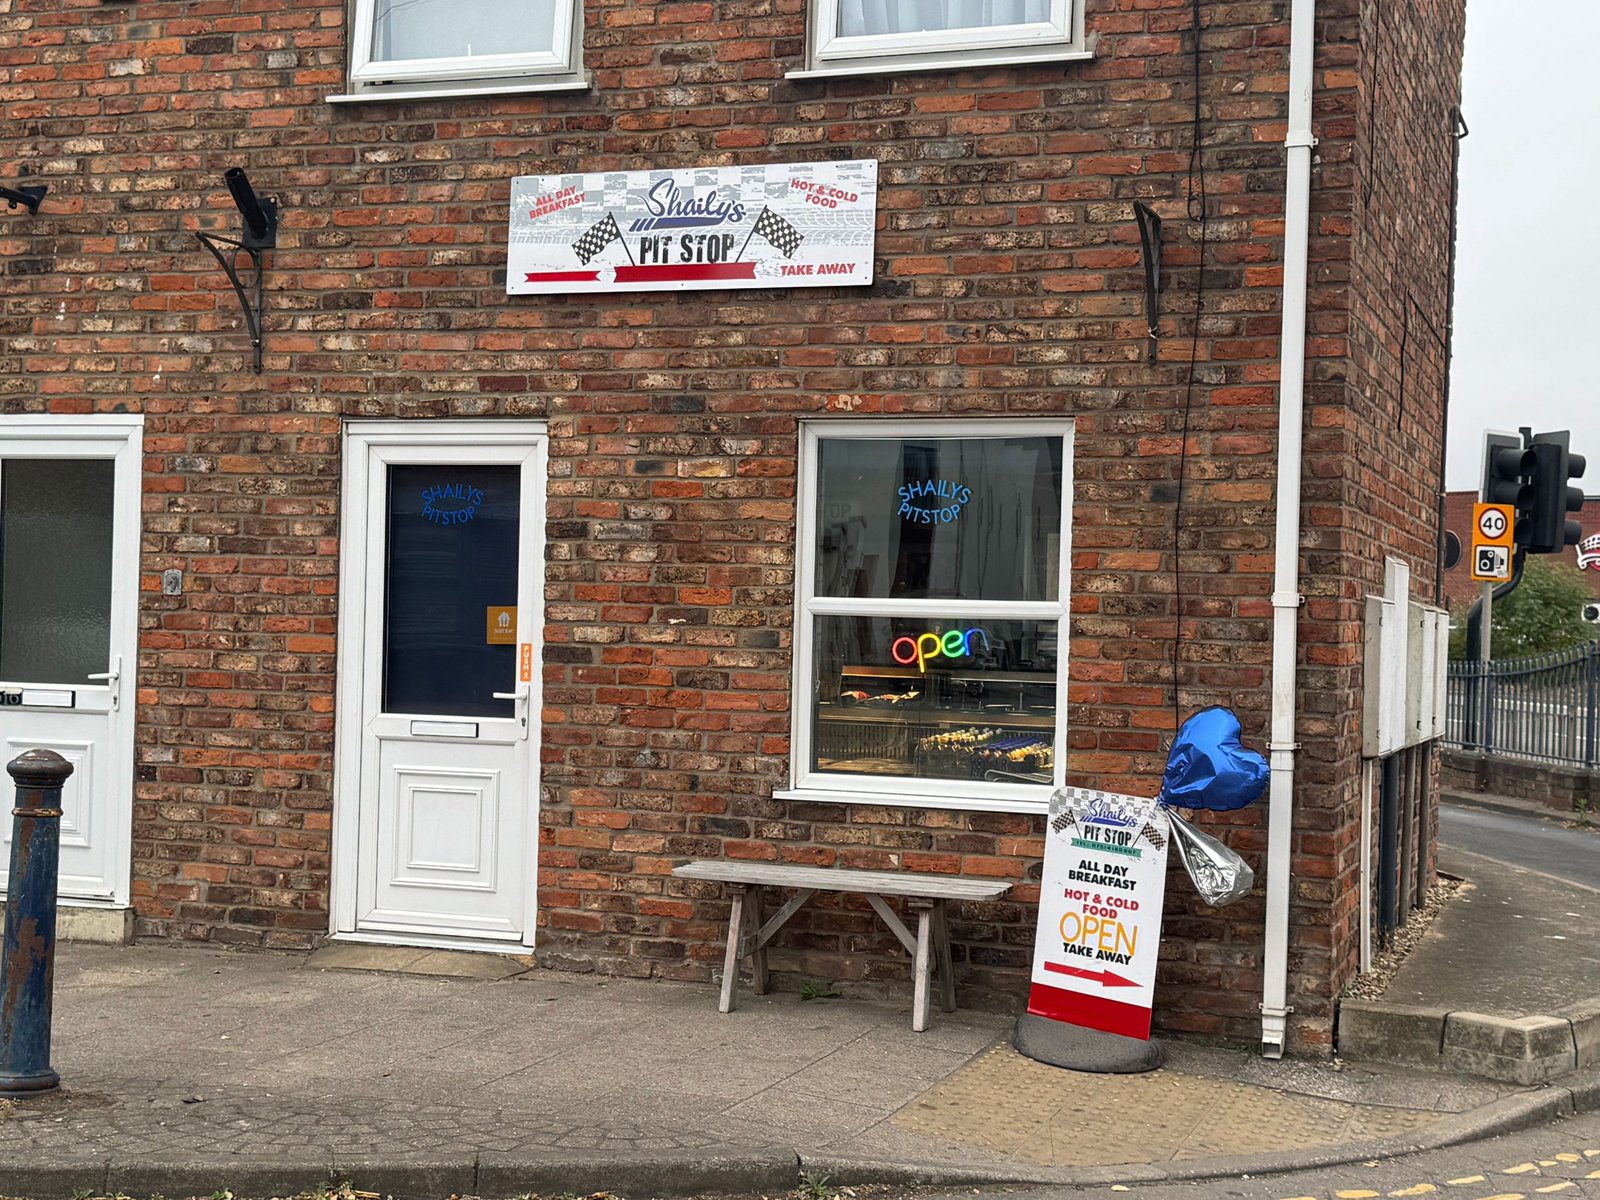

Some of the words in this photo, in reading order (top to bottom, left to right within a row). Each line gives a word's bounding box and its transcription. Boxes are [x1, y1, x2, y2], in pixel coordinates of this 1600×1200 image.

[535, 196, 553, 207] ALL
[556, 186, 577, 199] DAY
[640, 178, 747, 222] Shaily's
[791, 179, 814, 193] HOT
[816, 185, 827, 196] &
[828, 188, 858, 203] COLD
[805, 194, 838, 209] FOOD
[529, 193, 587, 219] BREAKFAST
[640, 235, 672, 265] PIT
[680, 233, 735, 264] STOP
[780, 265, 813, 276] TAKE
[817, 263, 856, 275] AWAY
[421, 483, 484, 506] SHAILYS
[898, 479, 972, 504] SHAILYS
[420, 504, 476, 526] PITSTOP
[897, 502, 961, 525] PITSTOP
[1482, 517, 1505, 531] 40
[892, 628, 990, 674] open
[0, 692, 19, 705] 10
[1083, 825, 1101, 842] PIT
[1104, 828, 1132, 847] STOP
[1079, 860, 1100, 872] ALL
[1103, 864, 1128, 877] DAY
[1068, 870, 1137, 891] BREAKFAST
[1064, 888, 1090, 902] HOT
[1092, 894, 1102, 905] &
[1106, 896, 1139, 911] COLD
[1082, 904, 1118, 919] FOOD
[1059, 911, 1138, 957] OPEN
[1063, 942, 1093, 958] TAKE
[1095, 949, 1132, 965] AWAY
